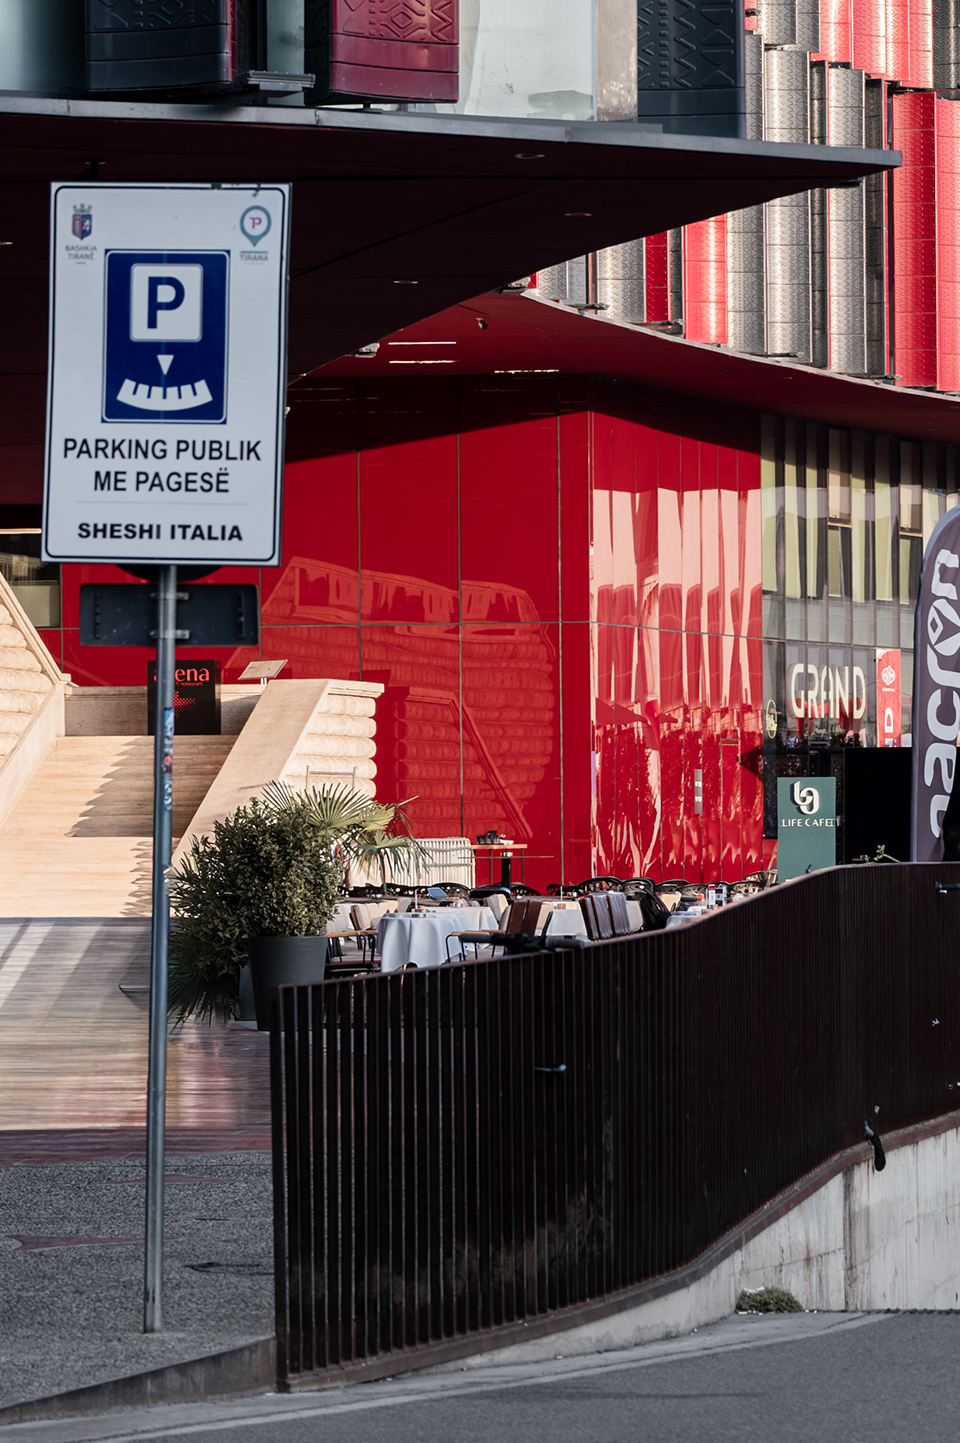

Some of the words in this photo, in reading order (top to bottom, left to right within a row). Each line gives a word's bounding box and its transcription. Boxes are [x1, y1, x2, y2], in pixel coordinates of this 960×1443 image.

[147, 276, 185, 329] P
[64, 438, 168, 460] PARKING
[176, 440, 262, 461] PUBLIK
[94, 471, 127, 492] ME
[136, 468, 230, 493] PAGESË
[78, 523, 161, 540] SHESHI
[170, 523, 243, 542] ITALIA
[153, 667, 210, 682] ena
[790, 663, 866, 719] GRAND
[781, 818, 803, 827] LIFE
